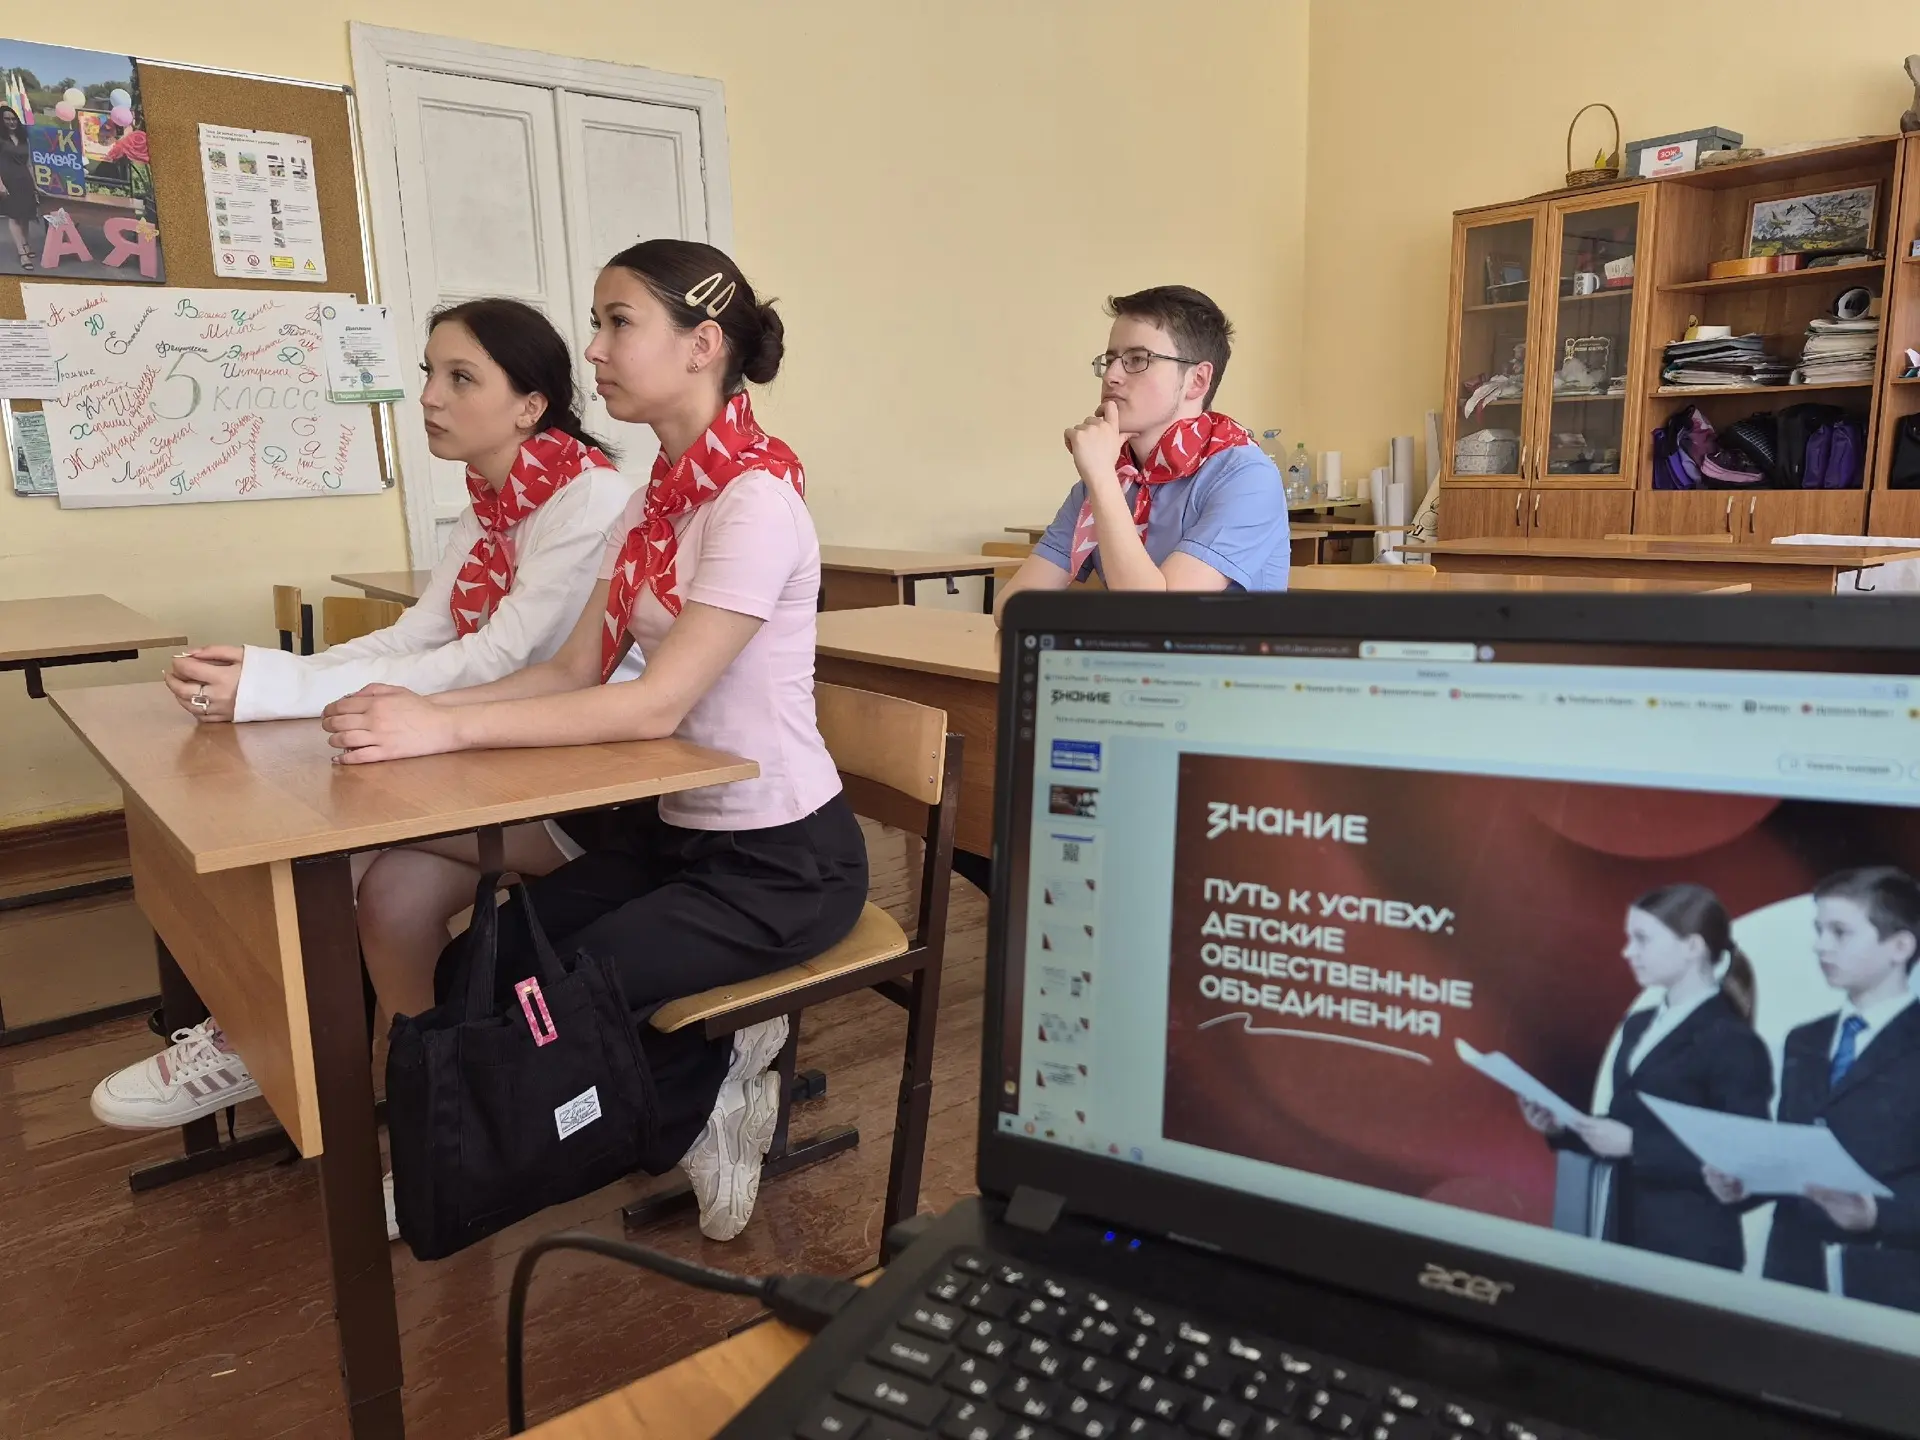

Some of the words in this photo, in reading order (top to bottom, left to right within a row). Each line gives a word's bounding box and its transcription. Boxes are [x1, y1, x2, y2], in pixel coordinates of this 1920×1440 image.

[1201, 911, 1345, 953] ДЕТСКИЕ
[1204, 878, 1281, 910] ПУТЬ
[1288, 888, 1311, 914] К
[1318, 891, 1455, 935] УСПЕХУ:
[1200, 942, 1473, 1009] ОБЩЕСТВЕННЫЕ
[1199, 974, 1441, 1038] ОБЪЕДИНЕНИЯ
[1417, 1262, 1515, 1305] acer
